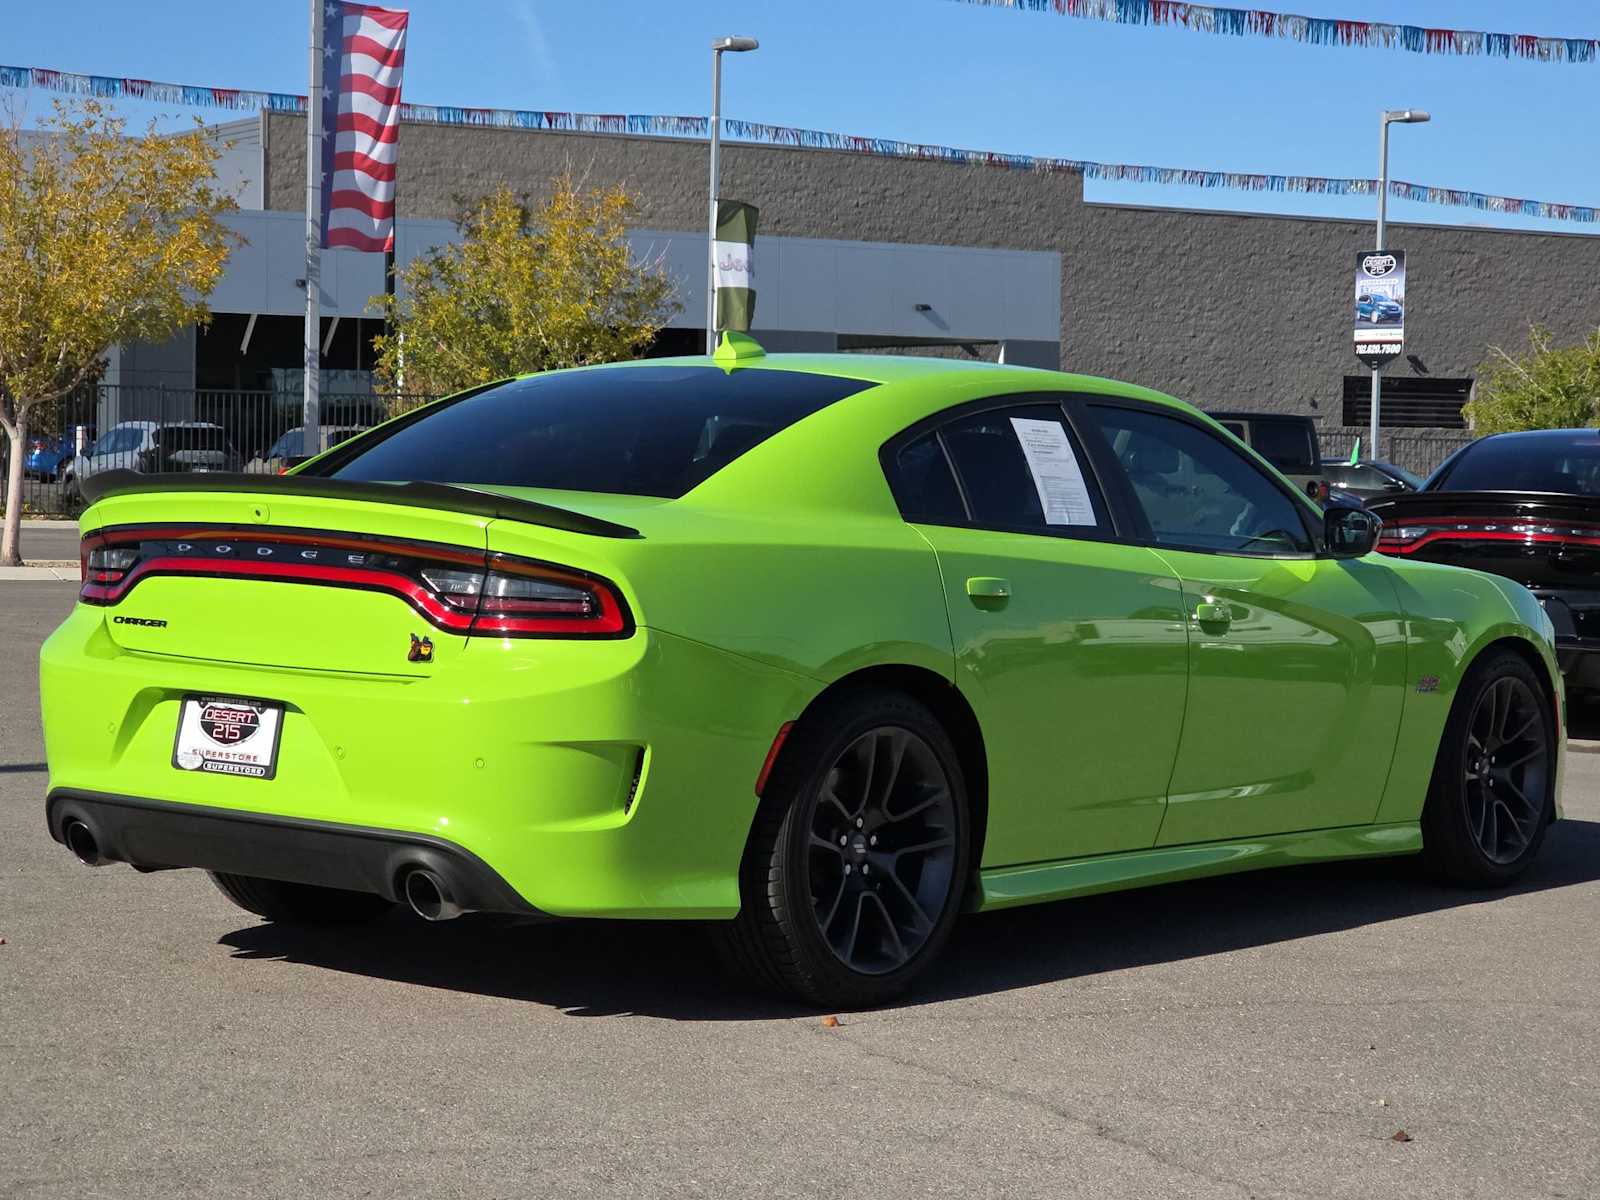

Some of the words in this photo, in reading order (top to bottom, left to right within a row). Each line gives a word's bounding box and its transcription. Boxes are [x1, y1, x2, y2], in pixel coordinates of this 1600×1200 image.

[176, 542, 366, 565] DODGE
[113, 615, 167, 628] CHARGER
[205, 709, 255, 724] DESERT
[212, 723, 241, 740] 215
[192, 748, 258, 763] SUPERSTORE
[205, 762, 262, 776] SUPERSTORE
